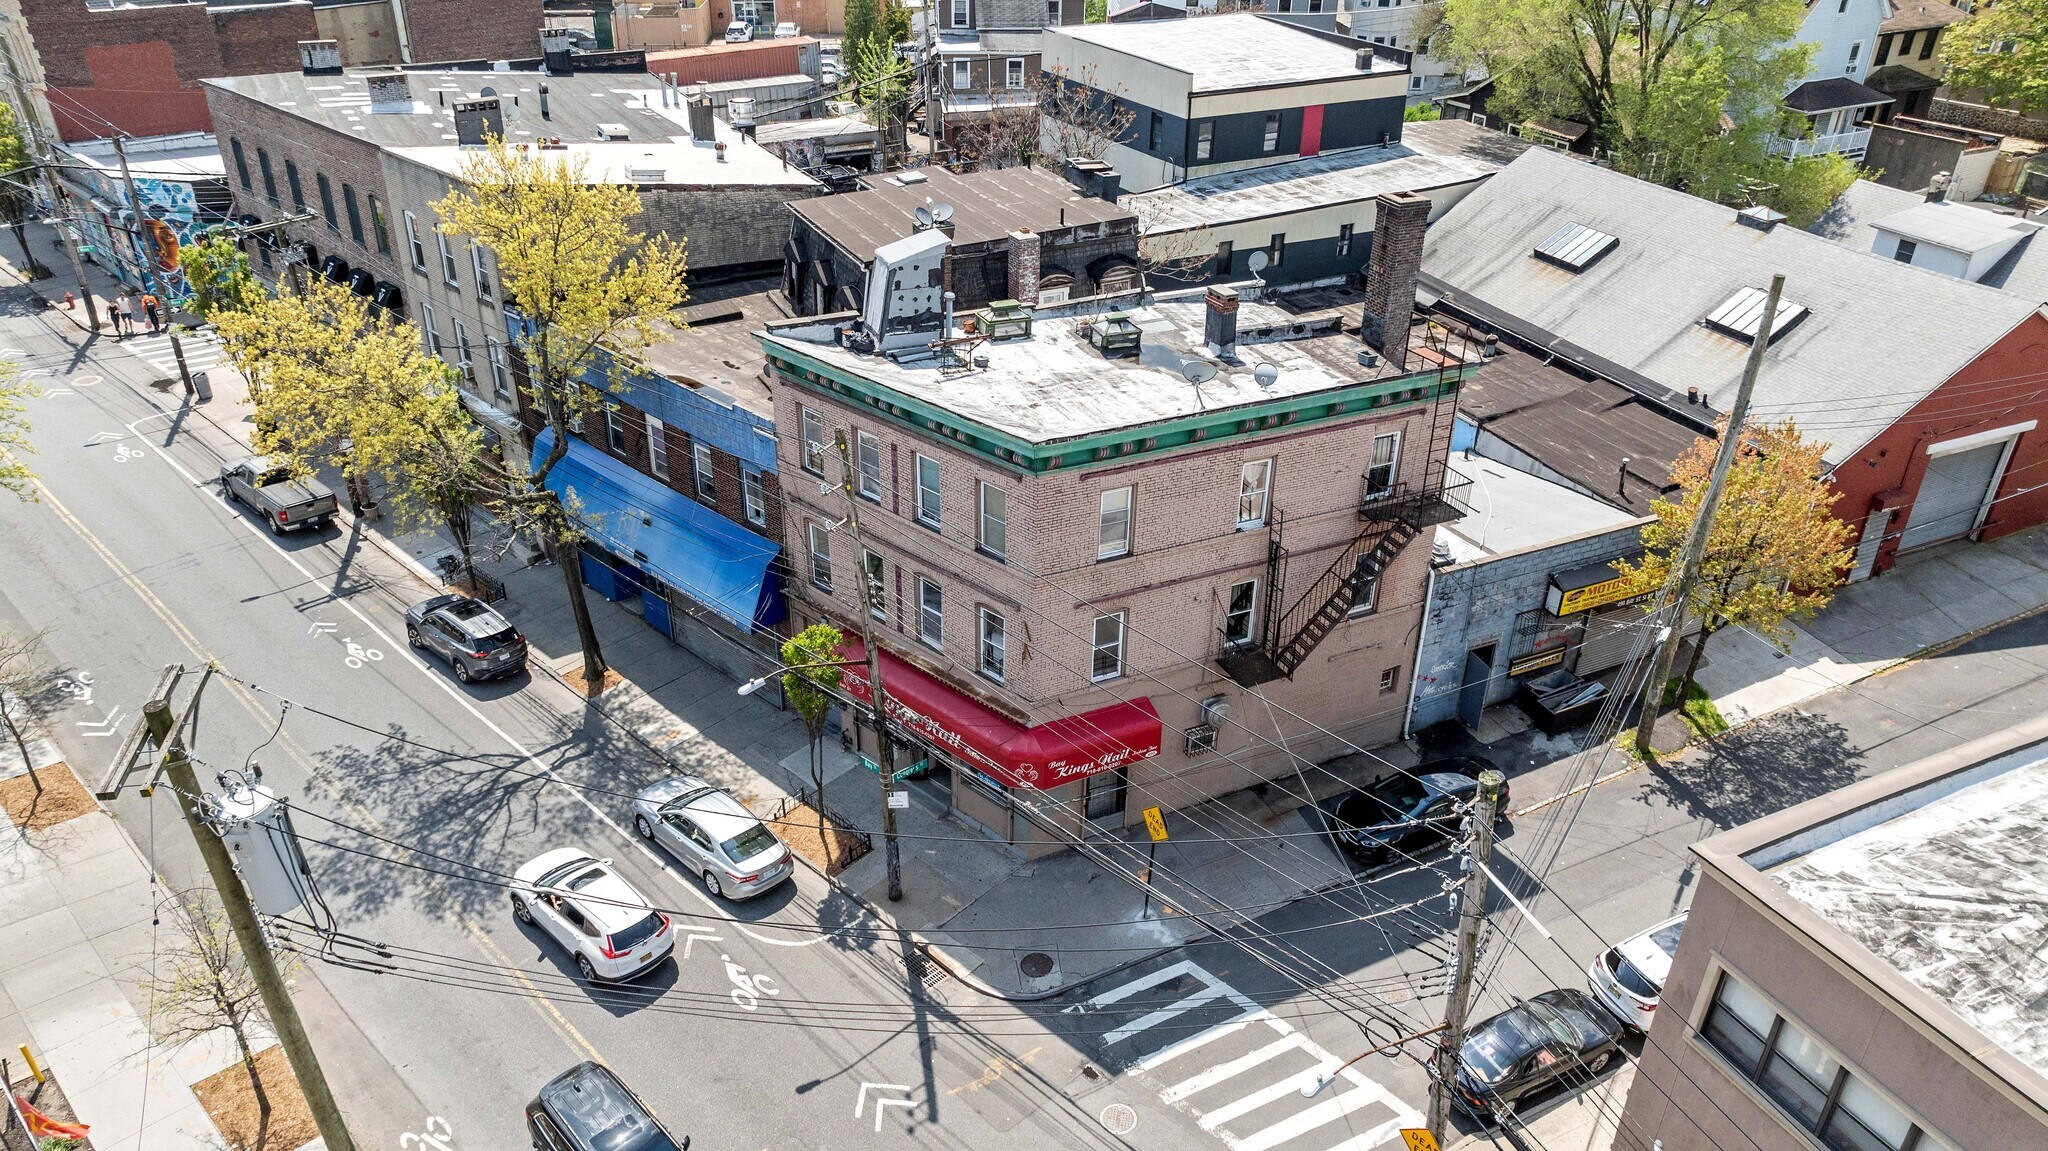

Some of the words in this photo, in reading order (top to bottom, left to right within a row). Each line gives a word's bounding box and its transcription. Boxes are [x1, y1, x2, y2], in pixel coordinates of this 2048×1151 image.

[1048, 760, 1066, 769] Bay
[1053, 761, 1095, 779] Kings
[1098, 748, 1130, 765] Nail
[1148, 810, 1163, 830] DEAD
[1149, 822, 1160, 836] END
[1411, 1131, 1438, 1151] DEA
